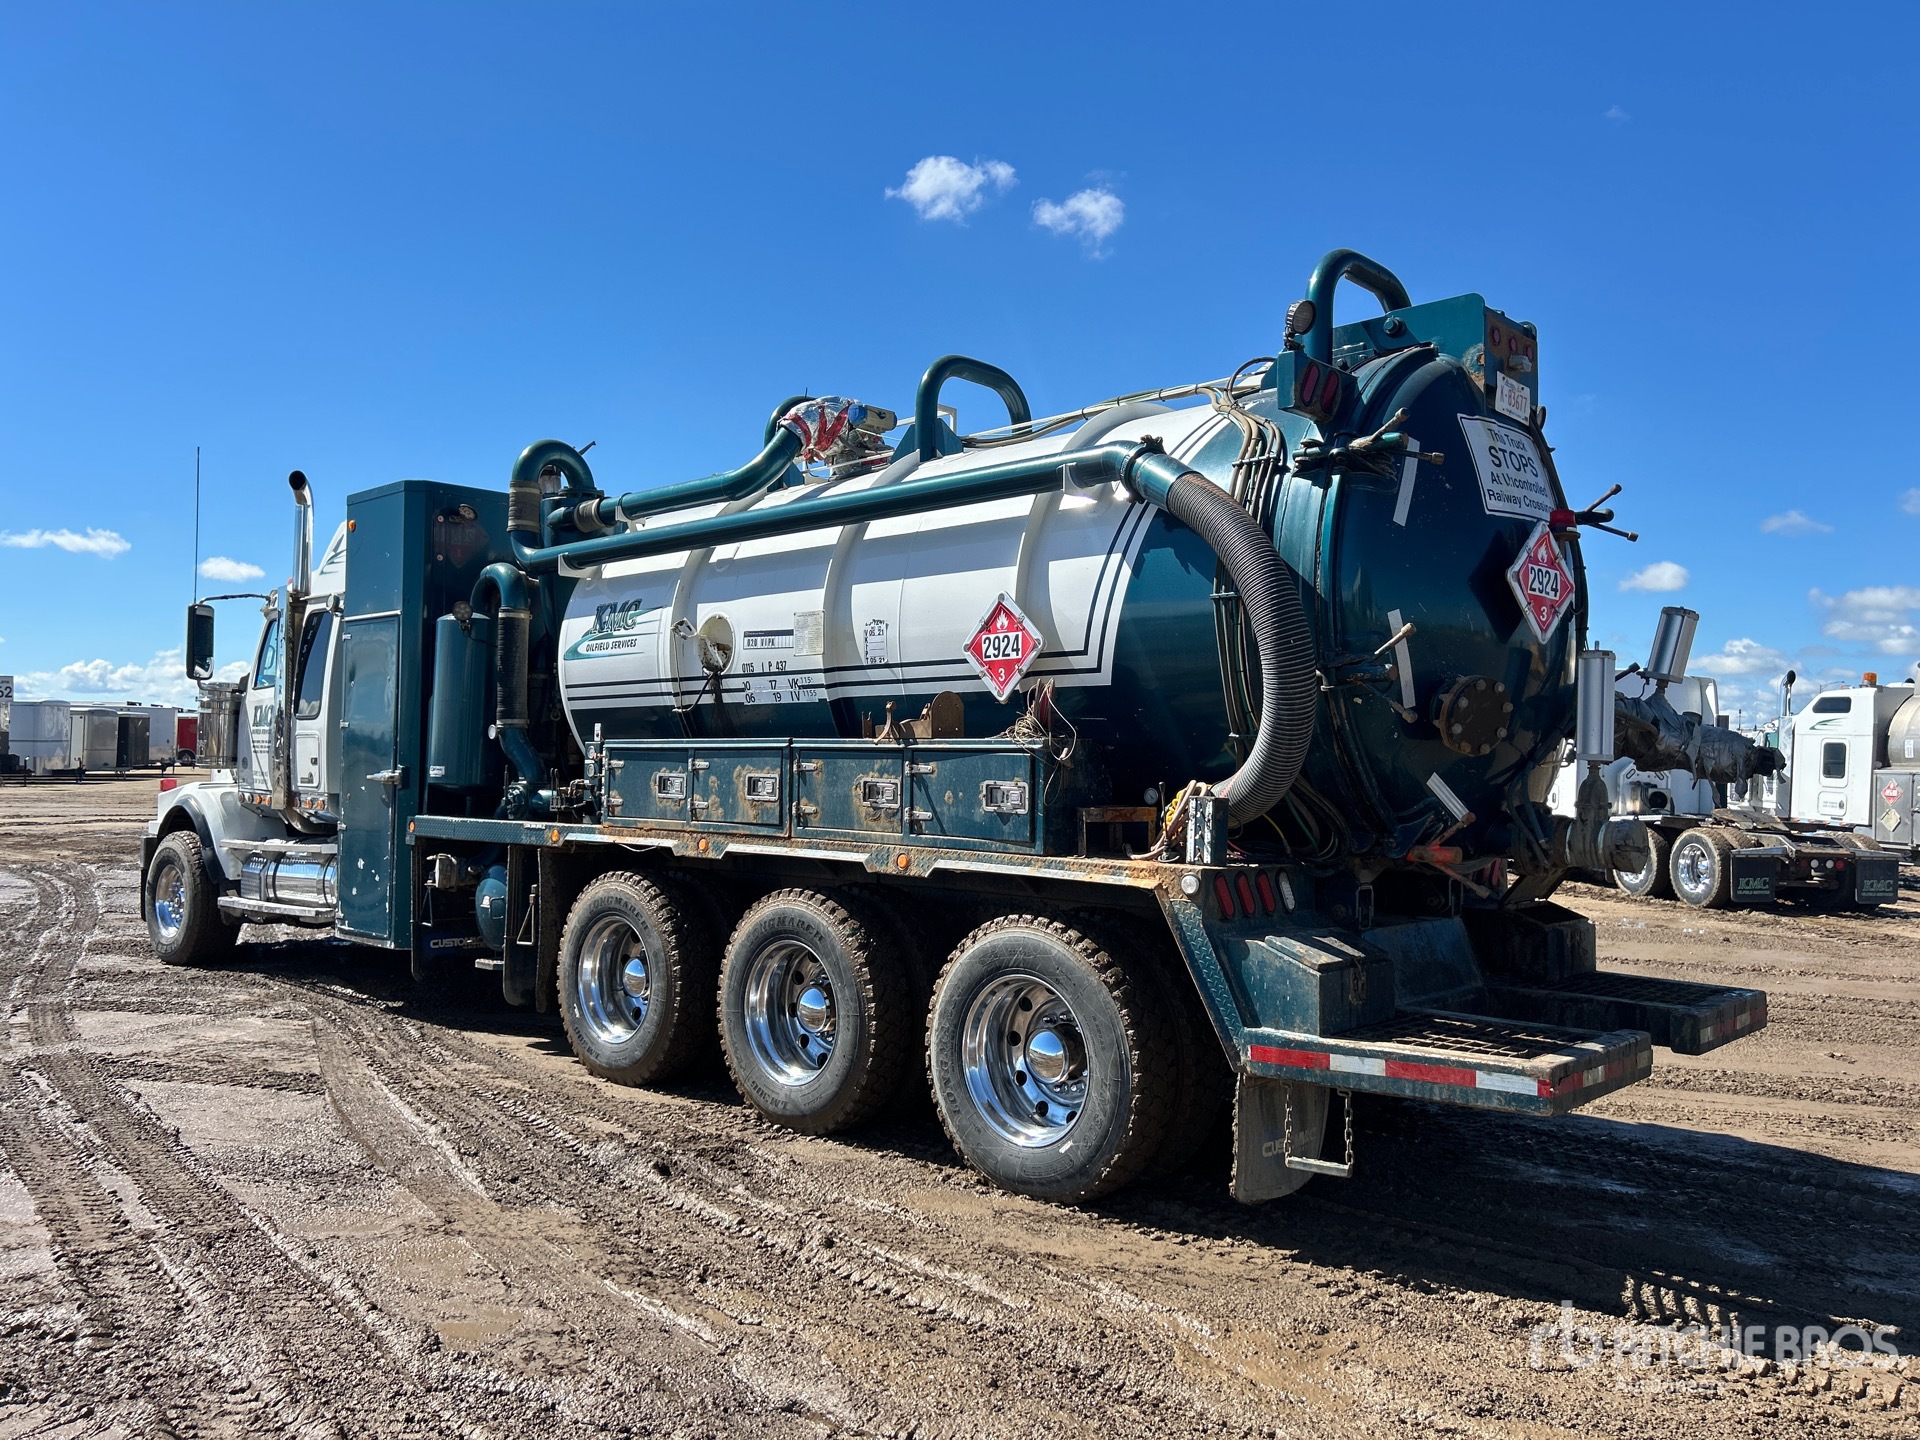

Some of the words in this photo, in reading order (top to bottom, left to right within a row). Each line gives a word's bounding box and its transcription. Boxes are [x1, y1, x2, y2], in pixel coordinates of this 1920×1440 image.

[1487, 428, 1506, 445] This
[1504, 434, 1527, 452] Truck
[1488, 446, 1539, 478] STOPS
[1490, 471, 1502, 485] At
[1487, 489, 1521, 508] Railway
[1529, 566, 1559, 598] 2924
[588, 598, 642, 634] KMC
[1540, 606, 1548, 621] 3
[585, 642, 610, 652] OILFIELD
[611, 639, 637, 650] SERVICES
[983, 634, 1020, 659] 2924
[768, 661, 772, 671] P
[775, 660, 787, 671] 437
[998, 668, 1005, 682] 3
[787, 678, 800, 690] VK
[745, 693, 755, 703] 06
[773, 692, 781, 702] 19
[1738, 877, 1769, 890] KMC
[1862, 879, 1894, 892] KMC
